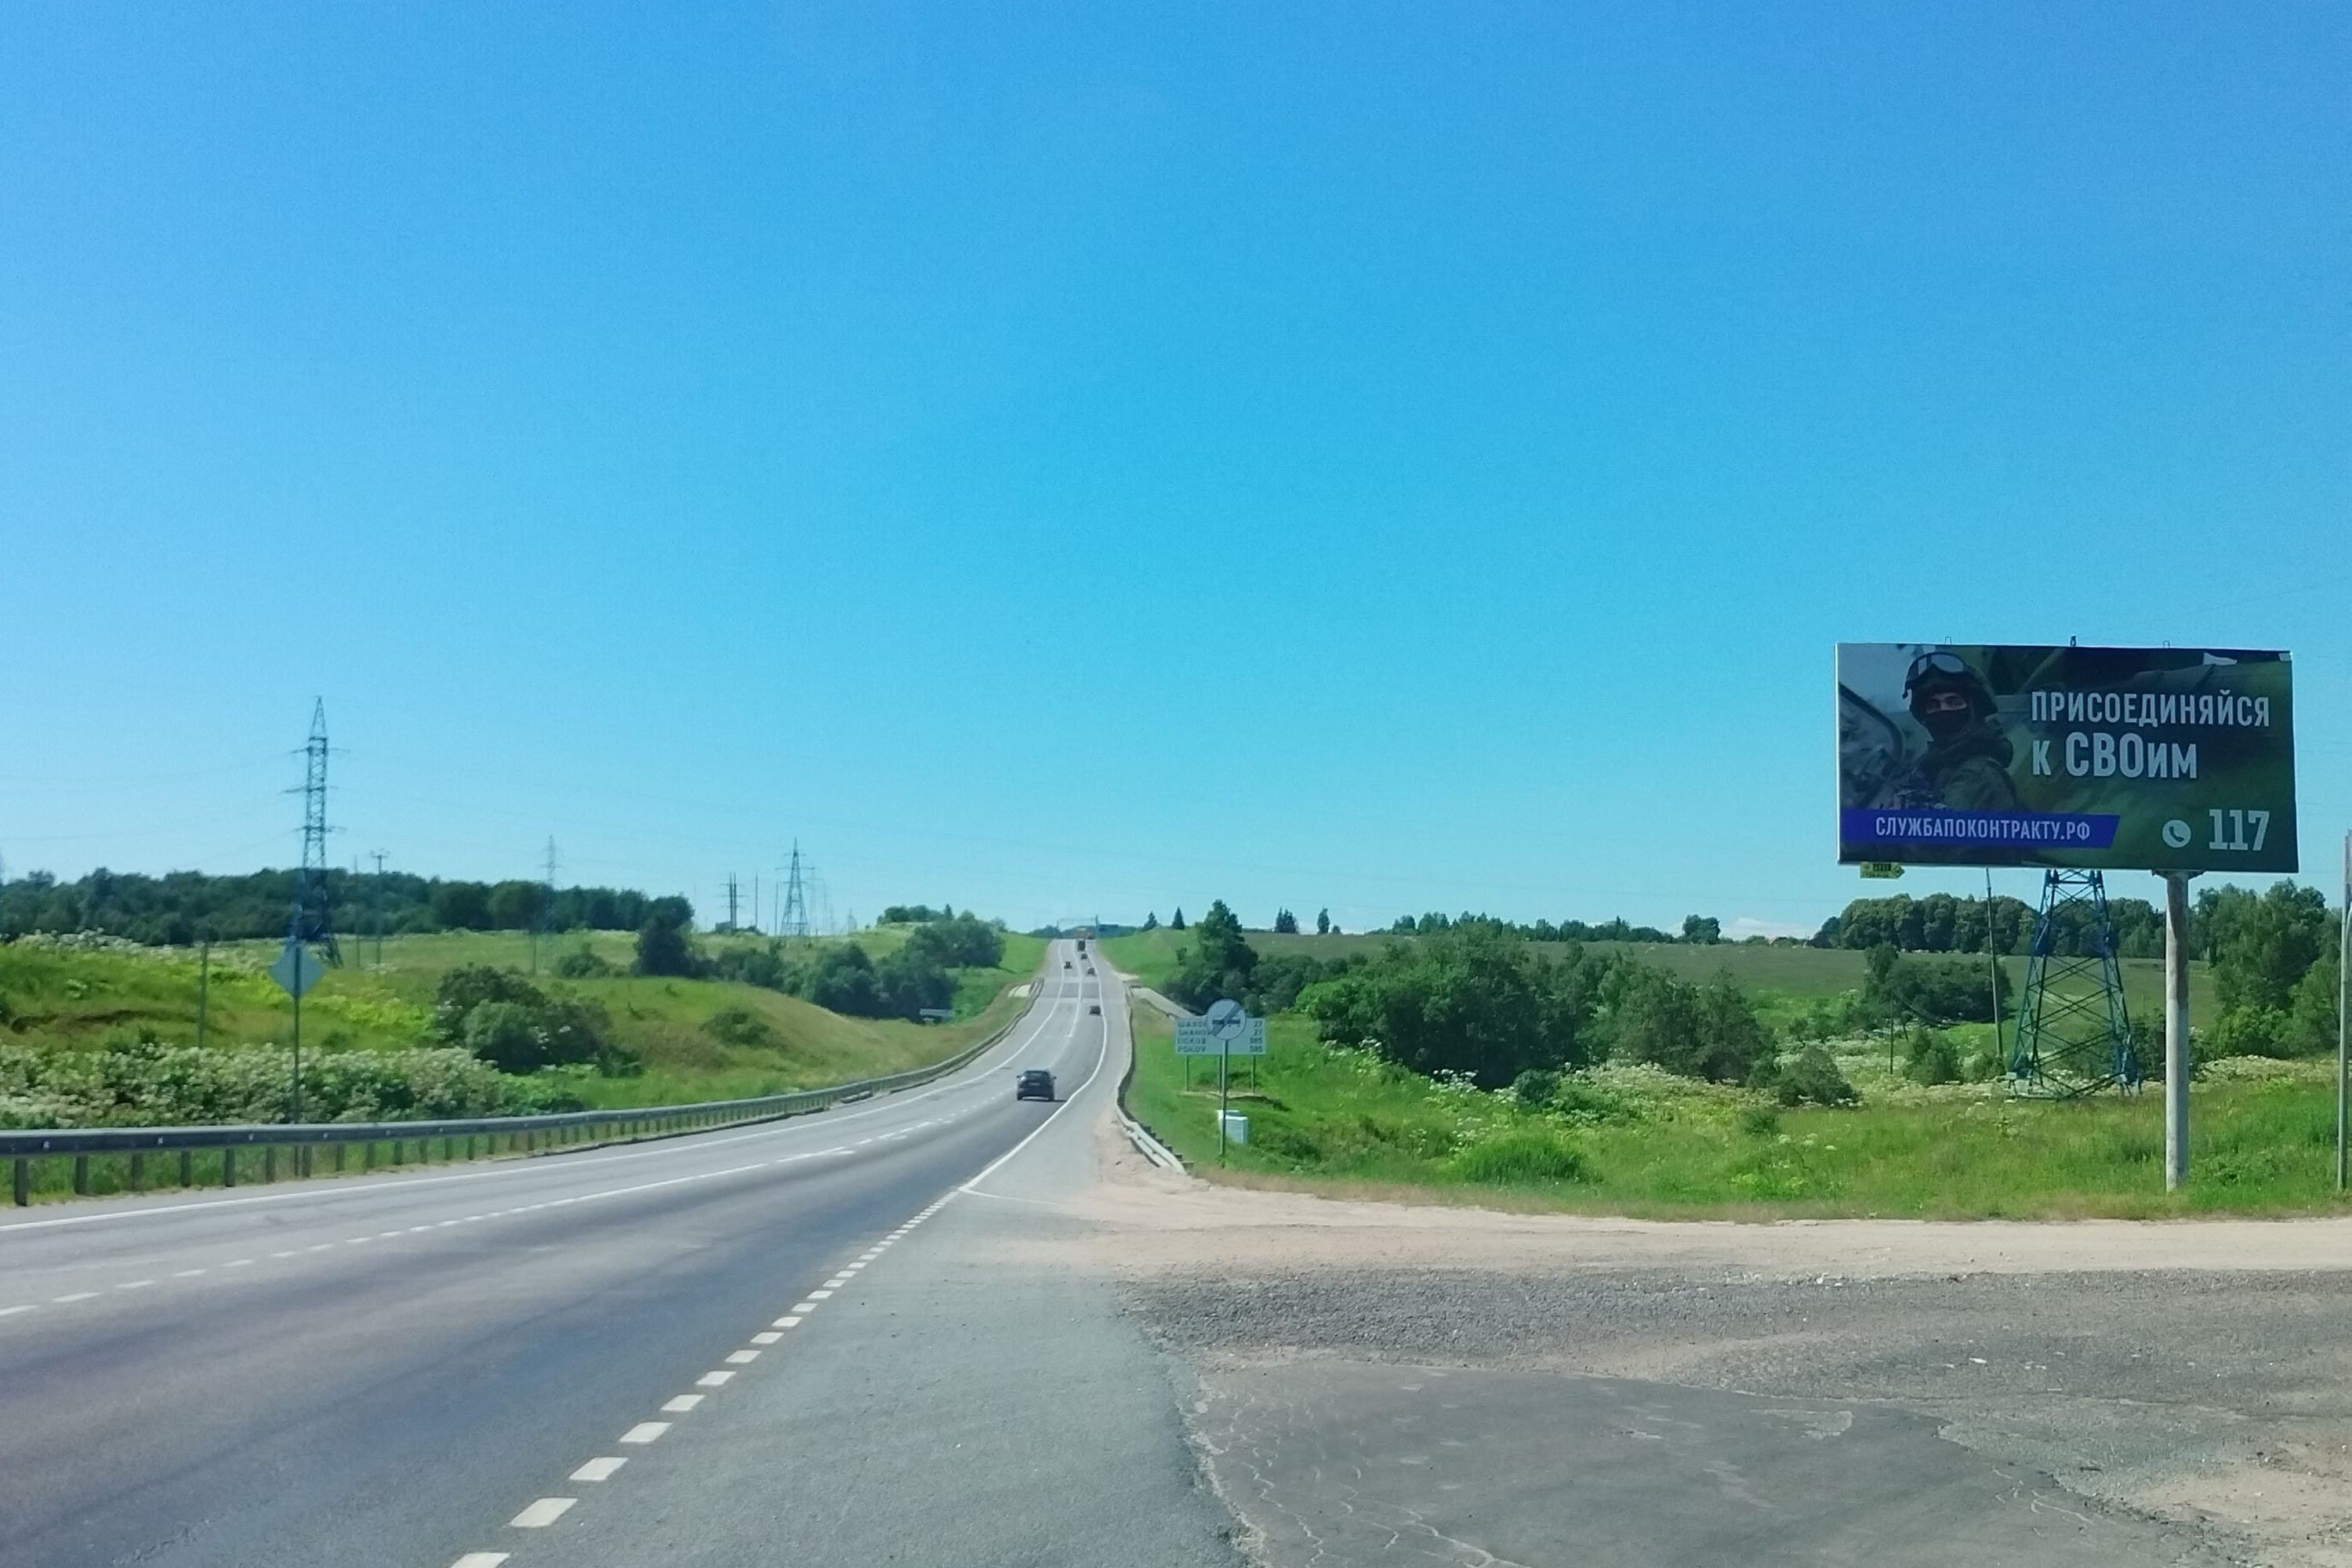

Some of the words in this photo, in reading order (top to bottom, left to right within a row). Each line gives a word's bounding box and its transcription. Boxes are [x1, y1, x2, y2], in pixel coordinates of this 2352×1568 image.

[2031, 689, 2270, 728] ПРИСОЕДИНЯЙСЯ
[1875, 817, 2090, 840] СЛУЖБАПОКОНТРАКТУ.РФ
[2209, 808, 2270, 851] 117
